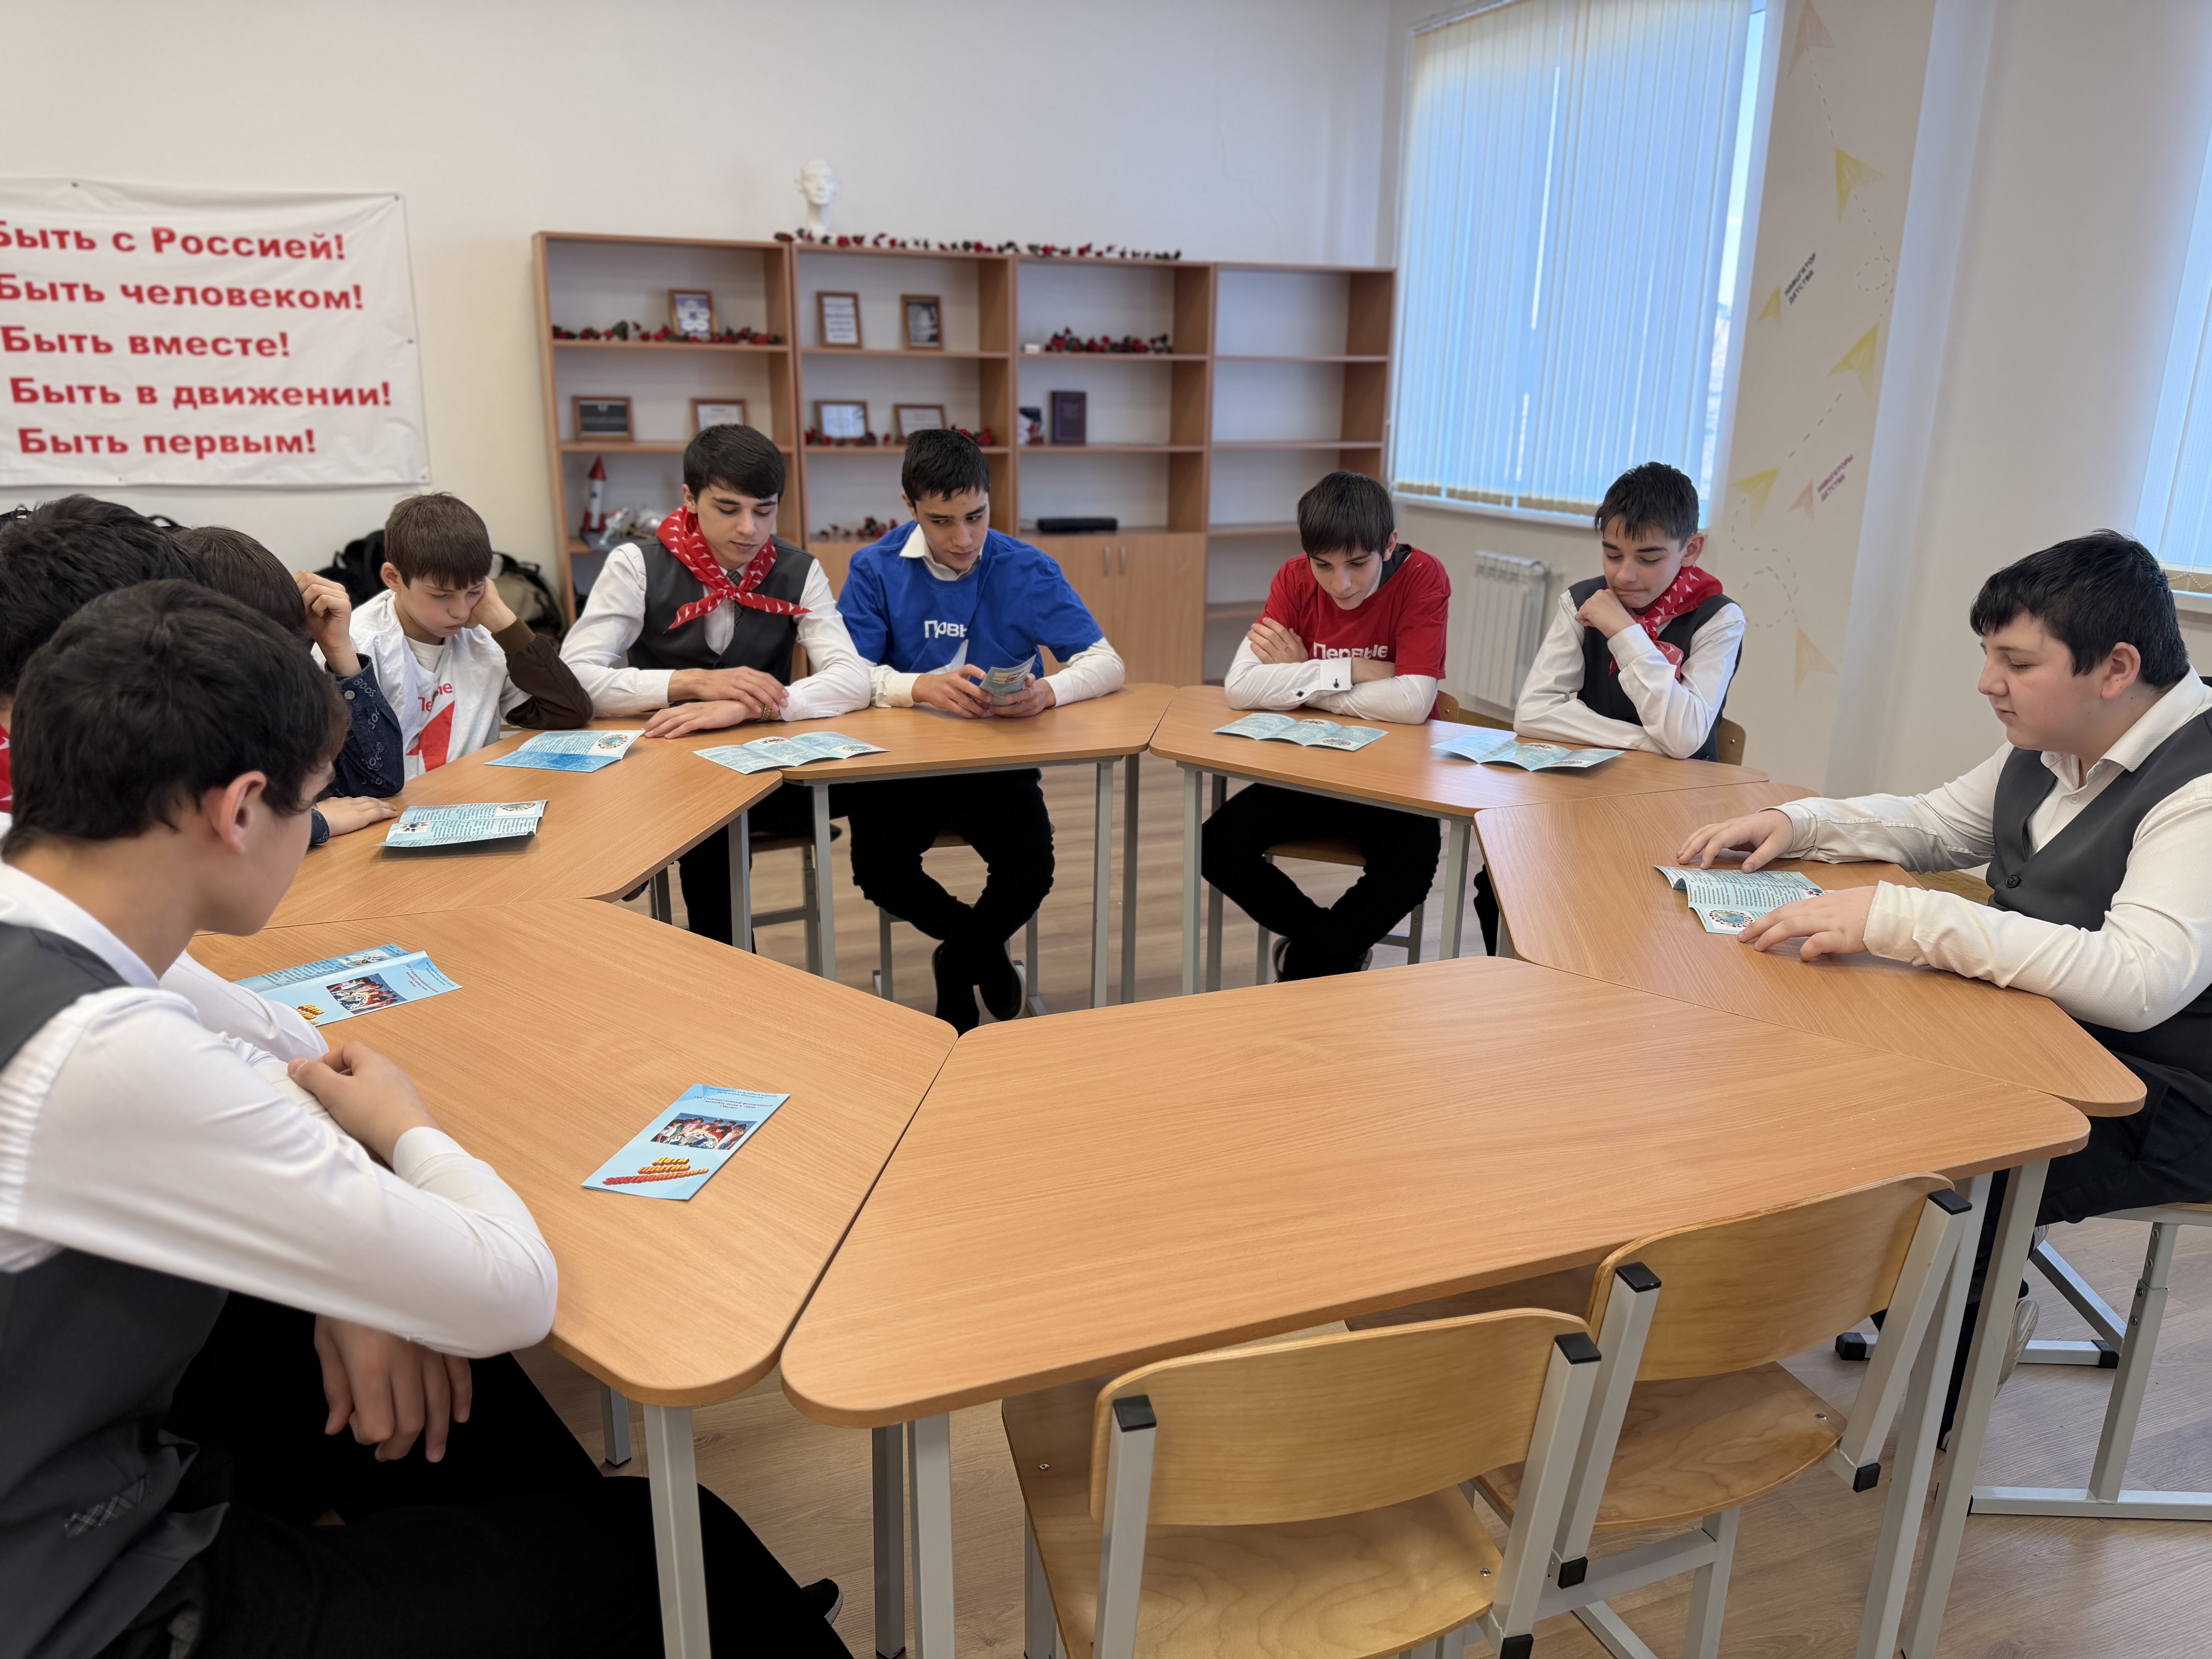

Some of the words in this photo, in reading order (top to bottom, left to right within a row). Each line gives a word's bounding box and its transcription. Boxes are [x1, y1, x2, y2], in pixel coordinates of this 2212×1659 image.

[112, 232, 135, 252] с
[151, 227, 344, 260] Россией!
[0, 273, 105, 302] Быть
[120, 285, 362, 309] человеком!
[1, 326, 113, 354] Быть
[129, 332, 289, 357] вместе!
[10, 377, 121, 404] Быть
[136, 386, 158, 405] в
[173, 381, 391, 409] движении!
[18, 428, 128, 454] Быть
[144, 429, 315, 460] первым!
